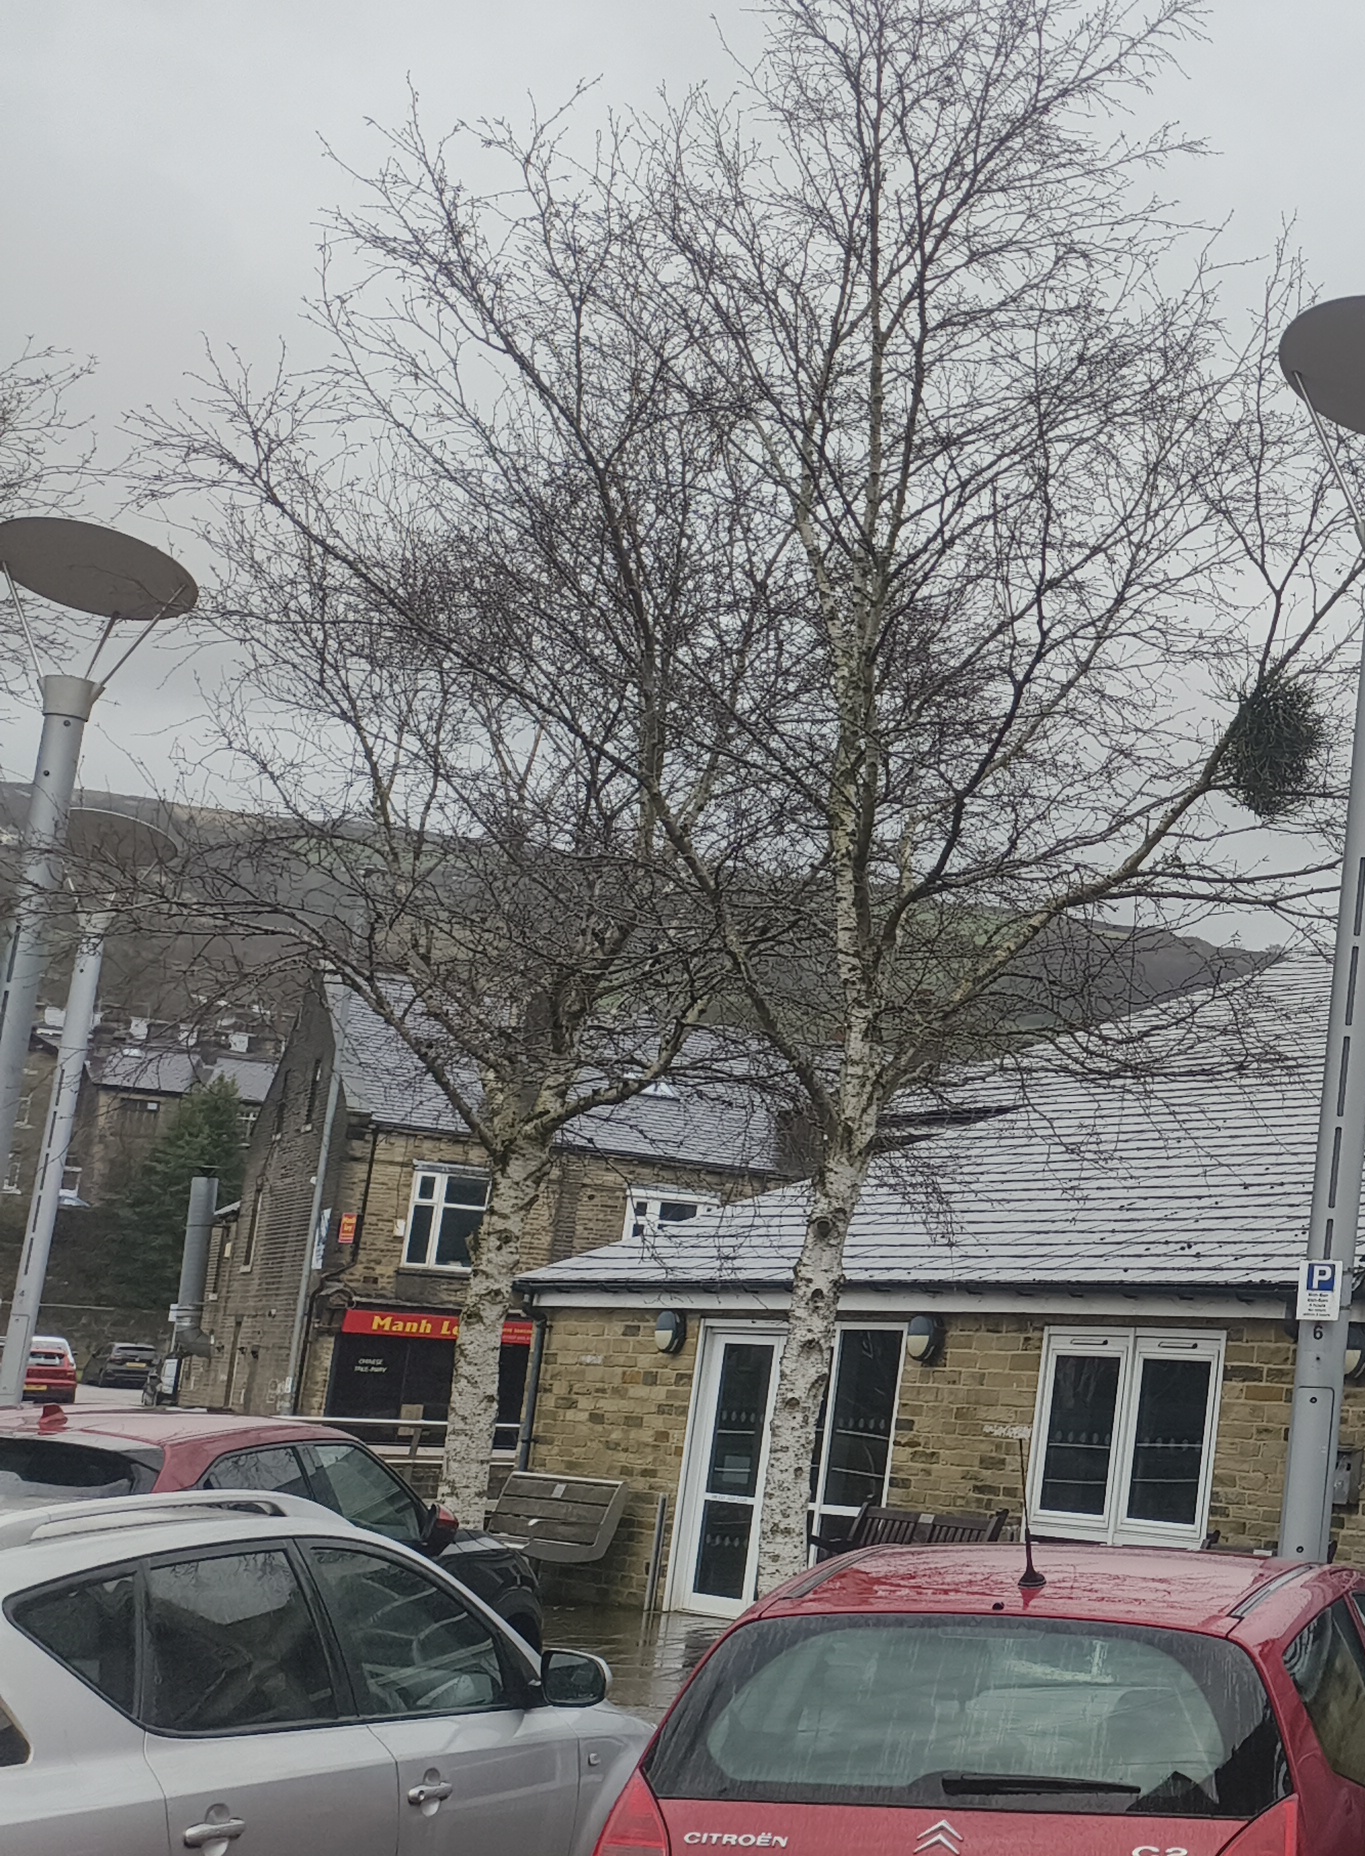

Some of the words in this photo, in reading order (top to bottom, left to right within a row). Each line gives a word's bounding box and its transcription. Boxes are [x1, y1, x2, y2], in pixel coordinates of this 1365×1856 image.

[1312, 1265, 1332, 1289] P
[371, 1315, 432, 1334] Manh
[440, 1320, 460, 1336] Lo
[1313, 1325, 1323, 1340] 6
[683, 1832, 789, 1848] CITROËN
